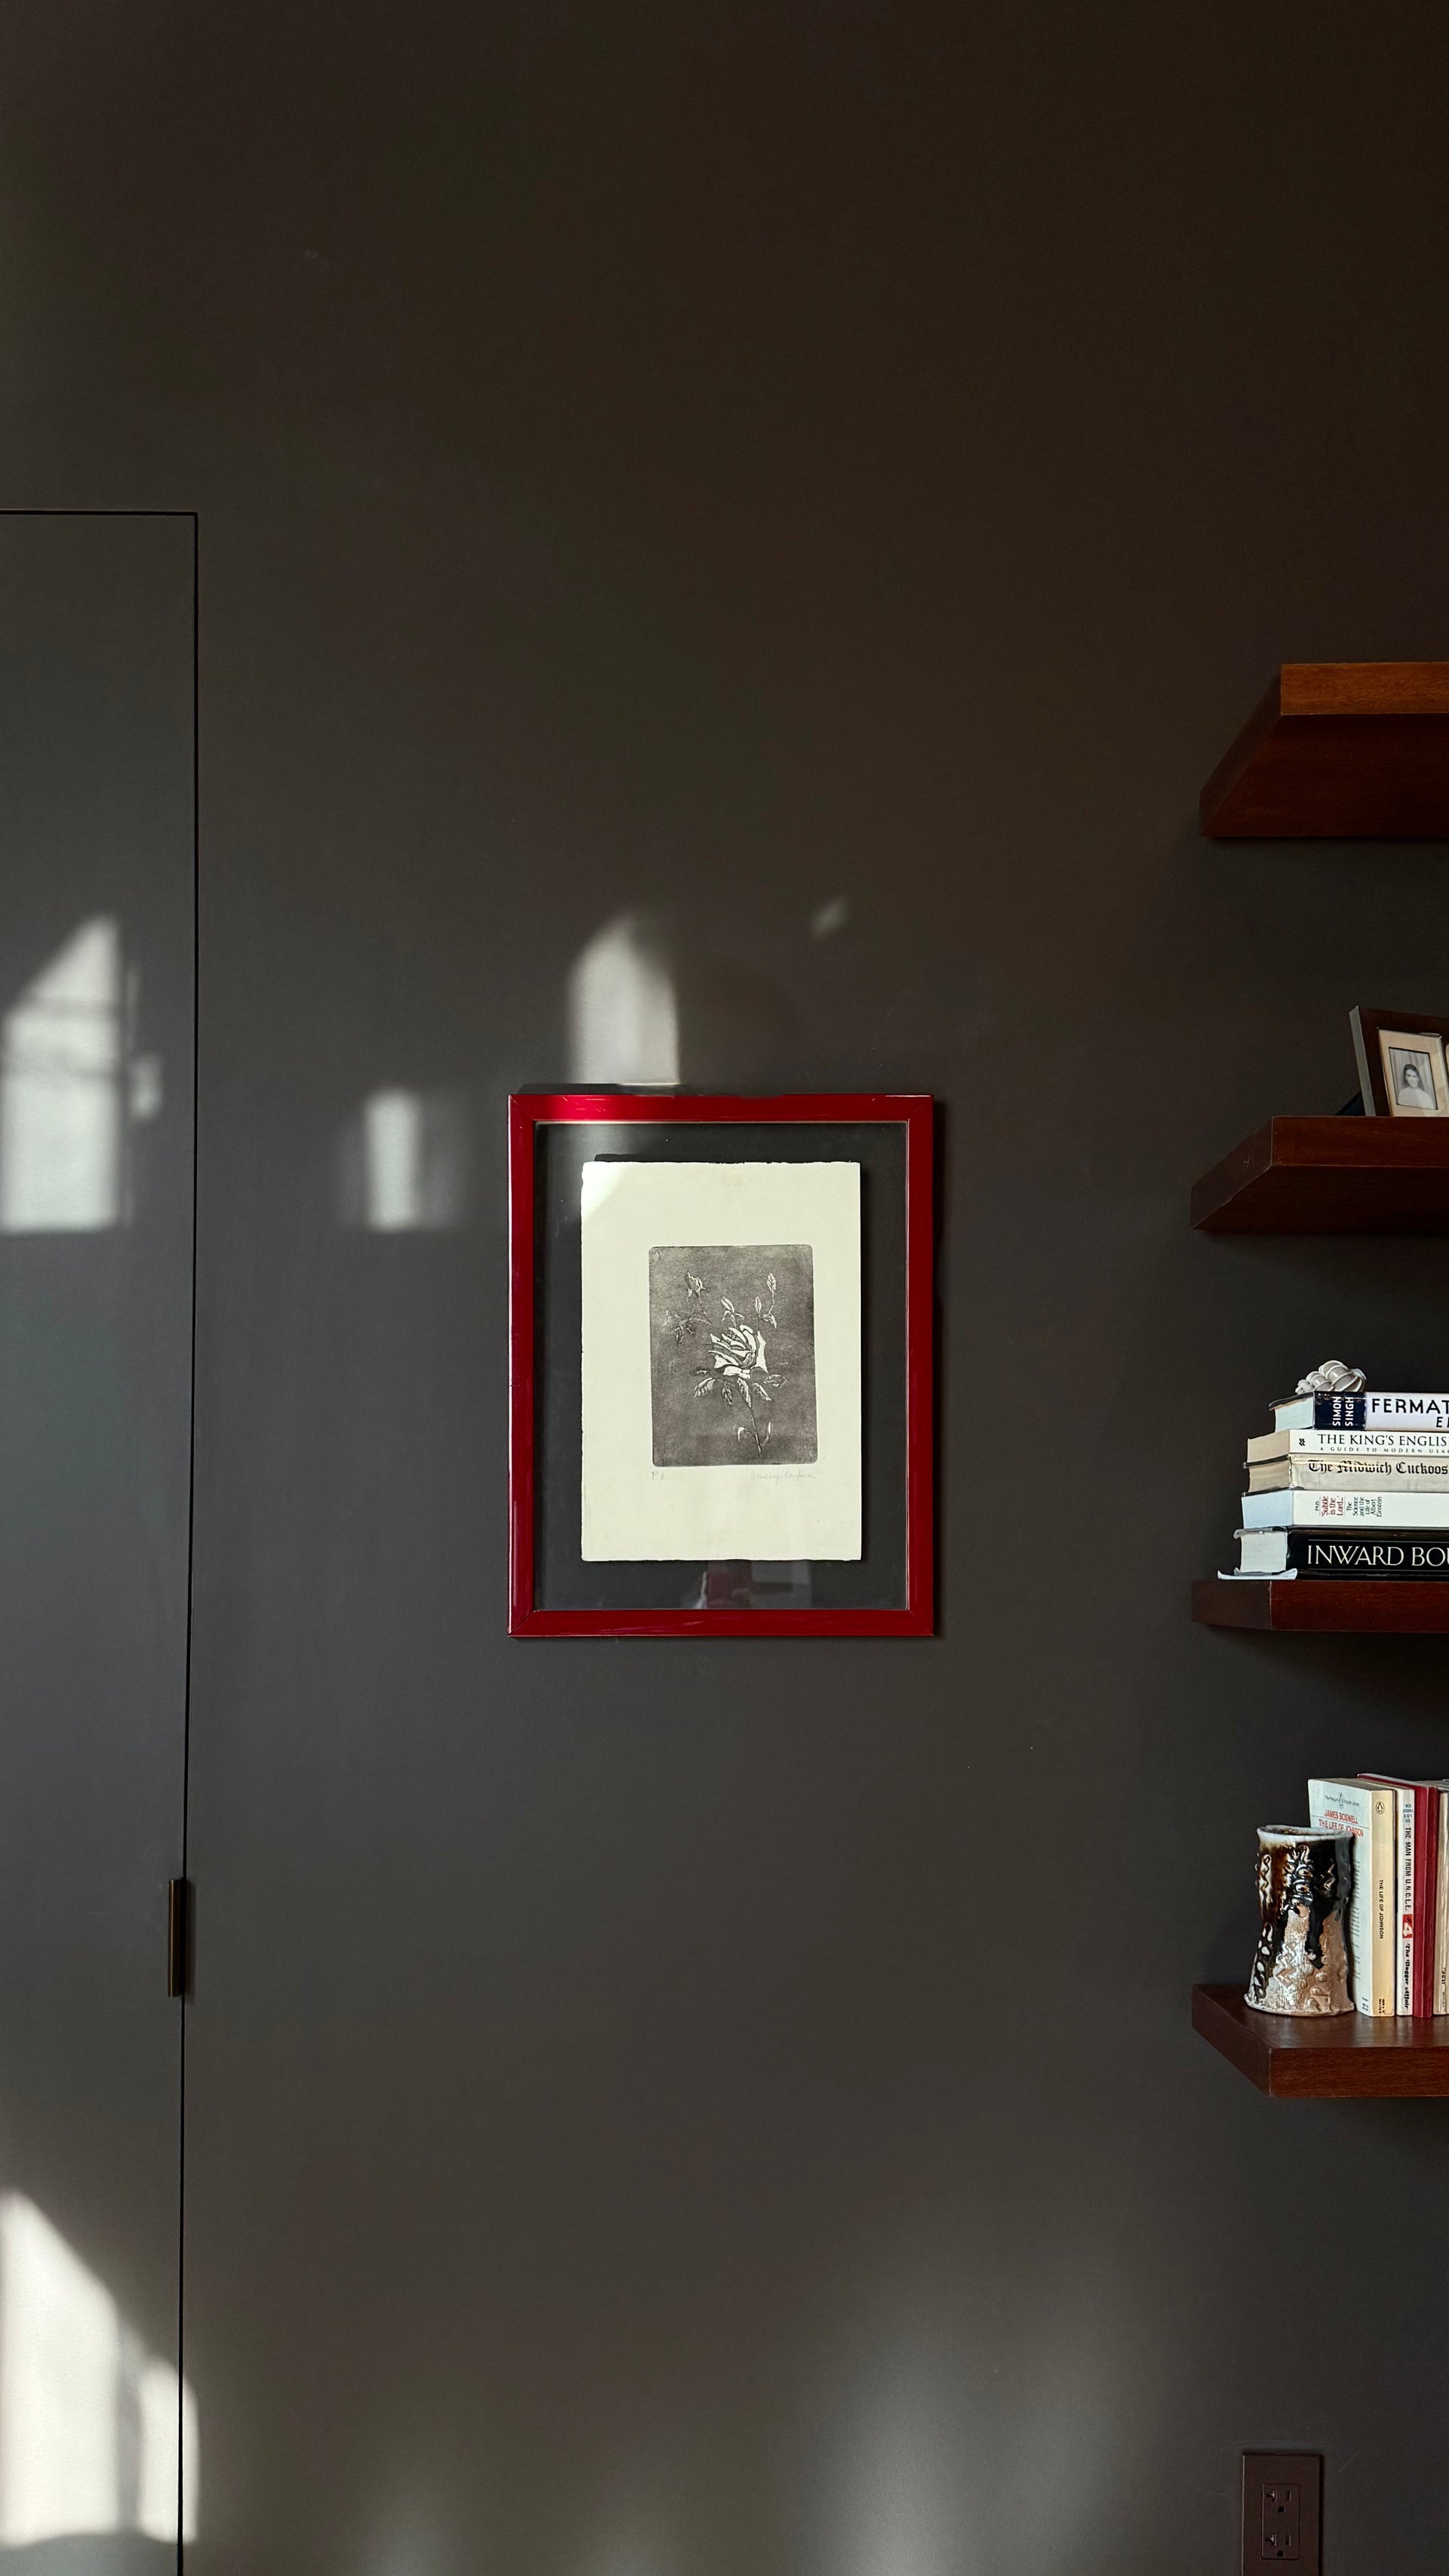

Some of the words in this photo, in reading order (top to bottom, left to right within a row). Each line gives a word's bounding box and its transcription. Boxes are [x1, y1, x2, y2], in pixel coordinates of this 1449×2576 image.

[1333, 1397, 1342, 1427] SIMON
[1345, 1397, 1354, 1427] SINGH
[1436, 1416, 1449, 1428] E
[1318, 1434, 1346, 1445] THE
[1350, 1434, 1395, 1446] KING'S
[1307, 1459, 1333, 1474] The
[1337, 1460, 1392, 1476] Midwich
[1396, 1461, 1449, 1475] Cuckoos
[1308, 1545, 1404, 1566] INWARD
[1318, 1818, 1328, 1828] THE
[1329, 1820, 1338, 1830] LIFE
[1324, 1809, 1339, 1819] JAMES
[1340, 1811, 1358, 1824] BOSWELL
